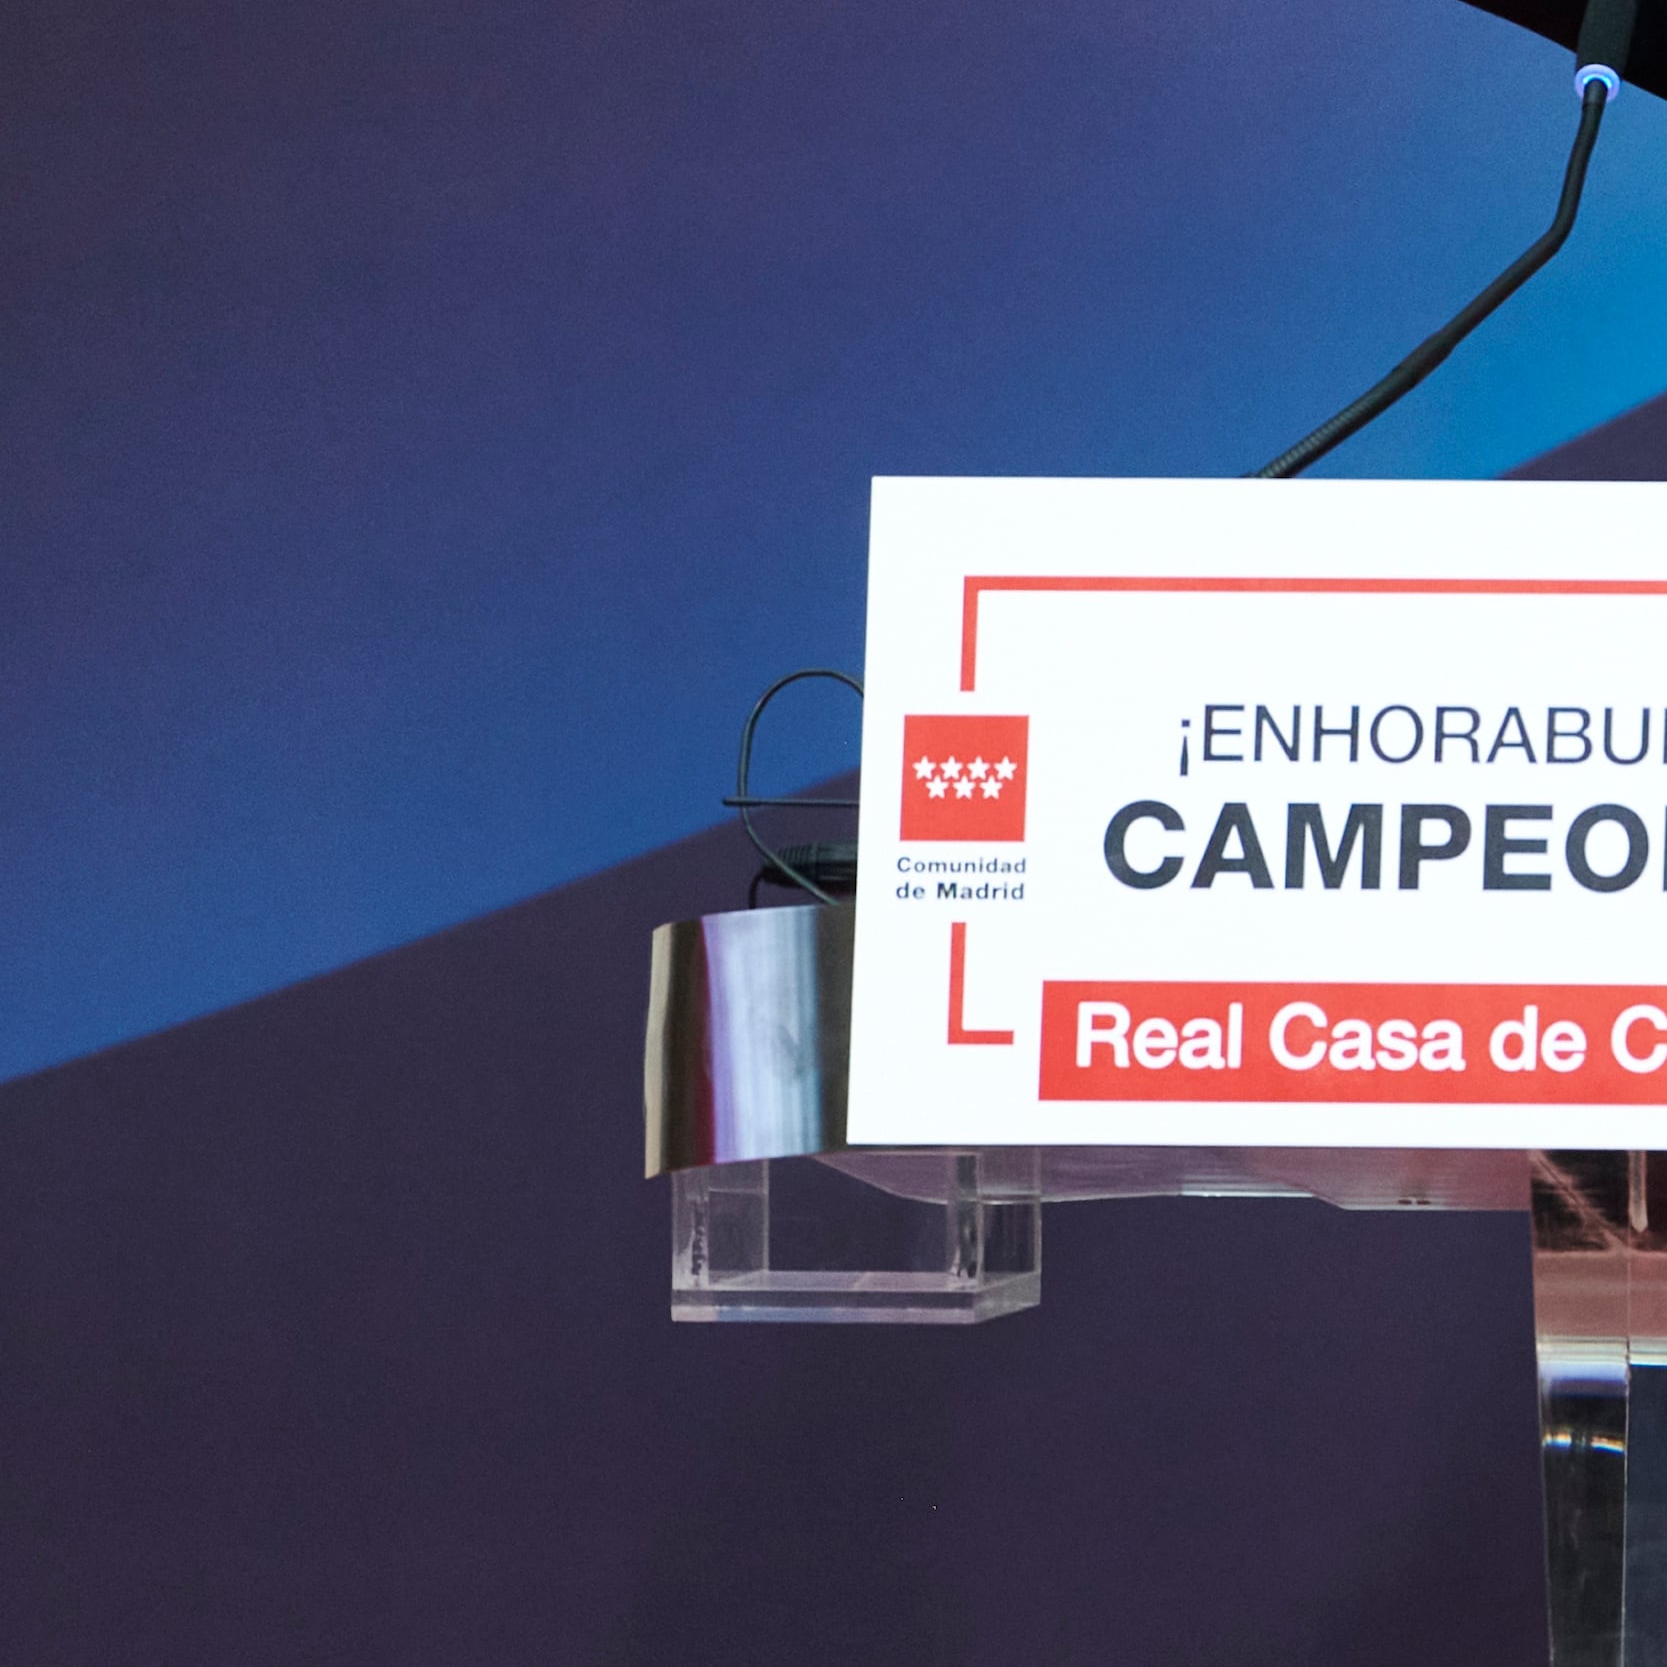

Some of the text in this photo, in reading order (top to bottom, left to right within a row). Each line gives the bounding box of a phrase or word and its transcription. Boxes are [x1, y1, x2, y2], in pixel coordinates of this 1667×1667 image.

[896, 856, 1026, 874] Comunidad
[895, 881, 1025, 900] de Madrid
[1074, 1000, 1244, 1071] Real
[1268, 1002, 1462, 1074] Casa
[1487, 1004, 1588, 1074] de
